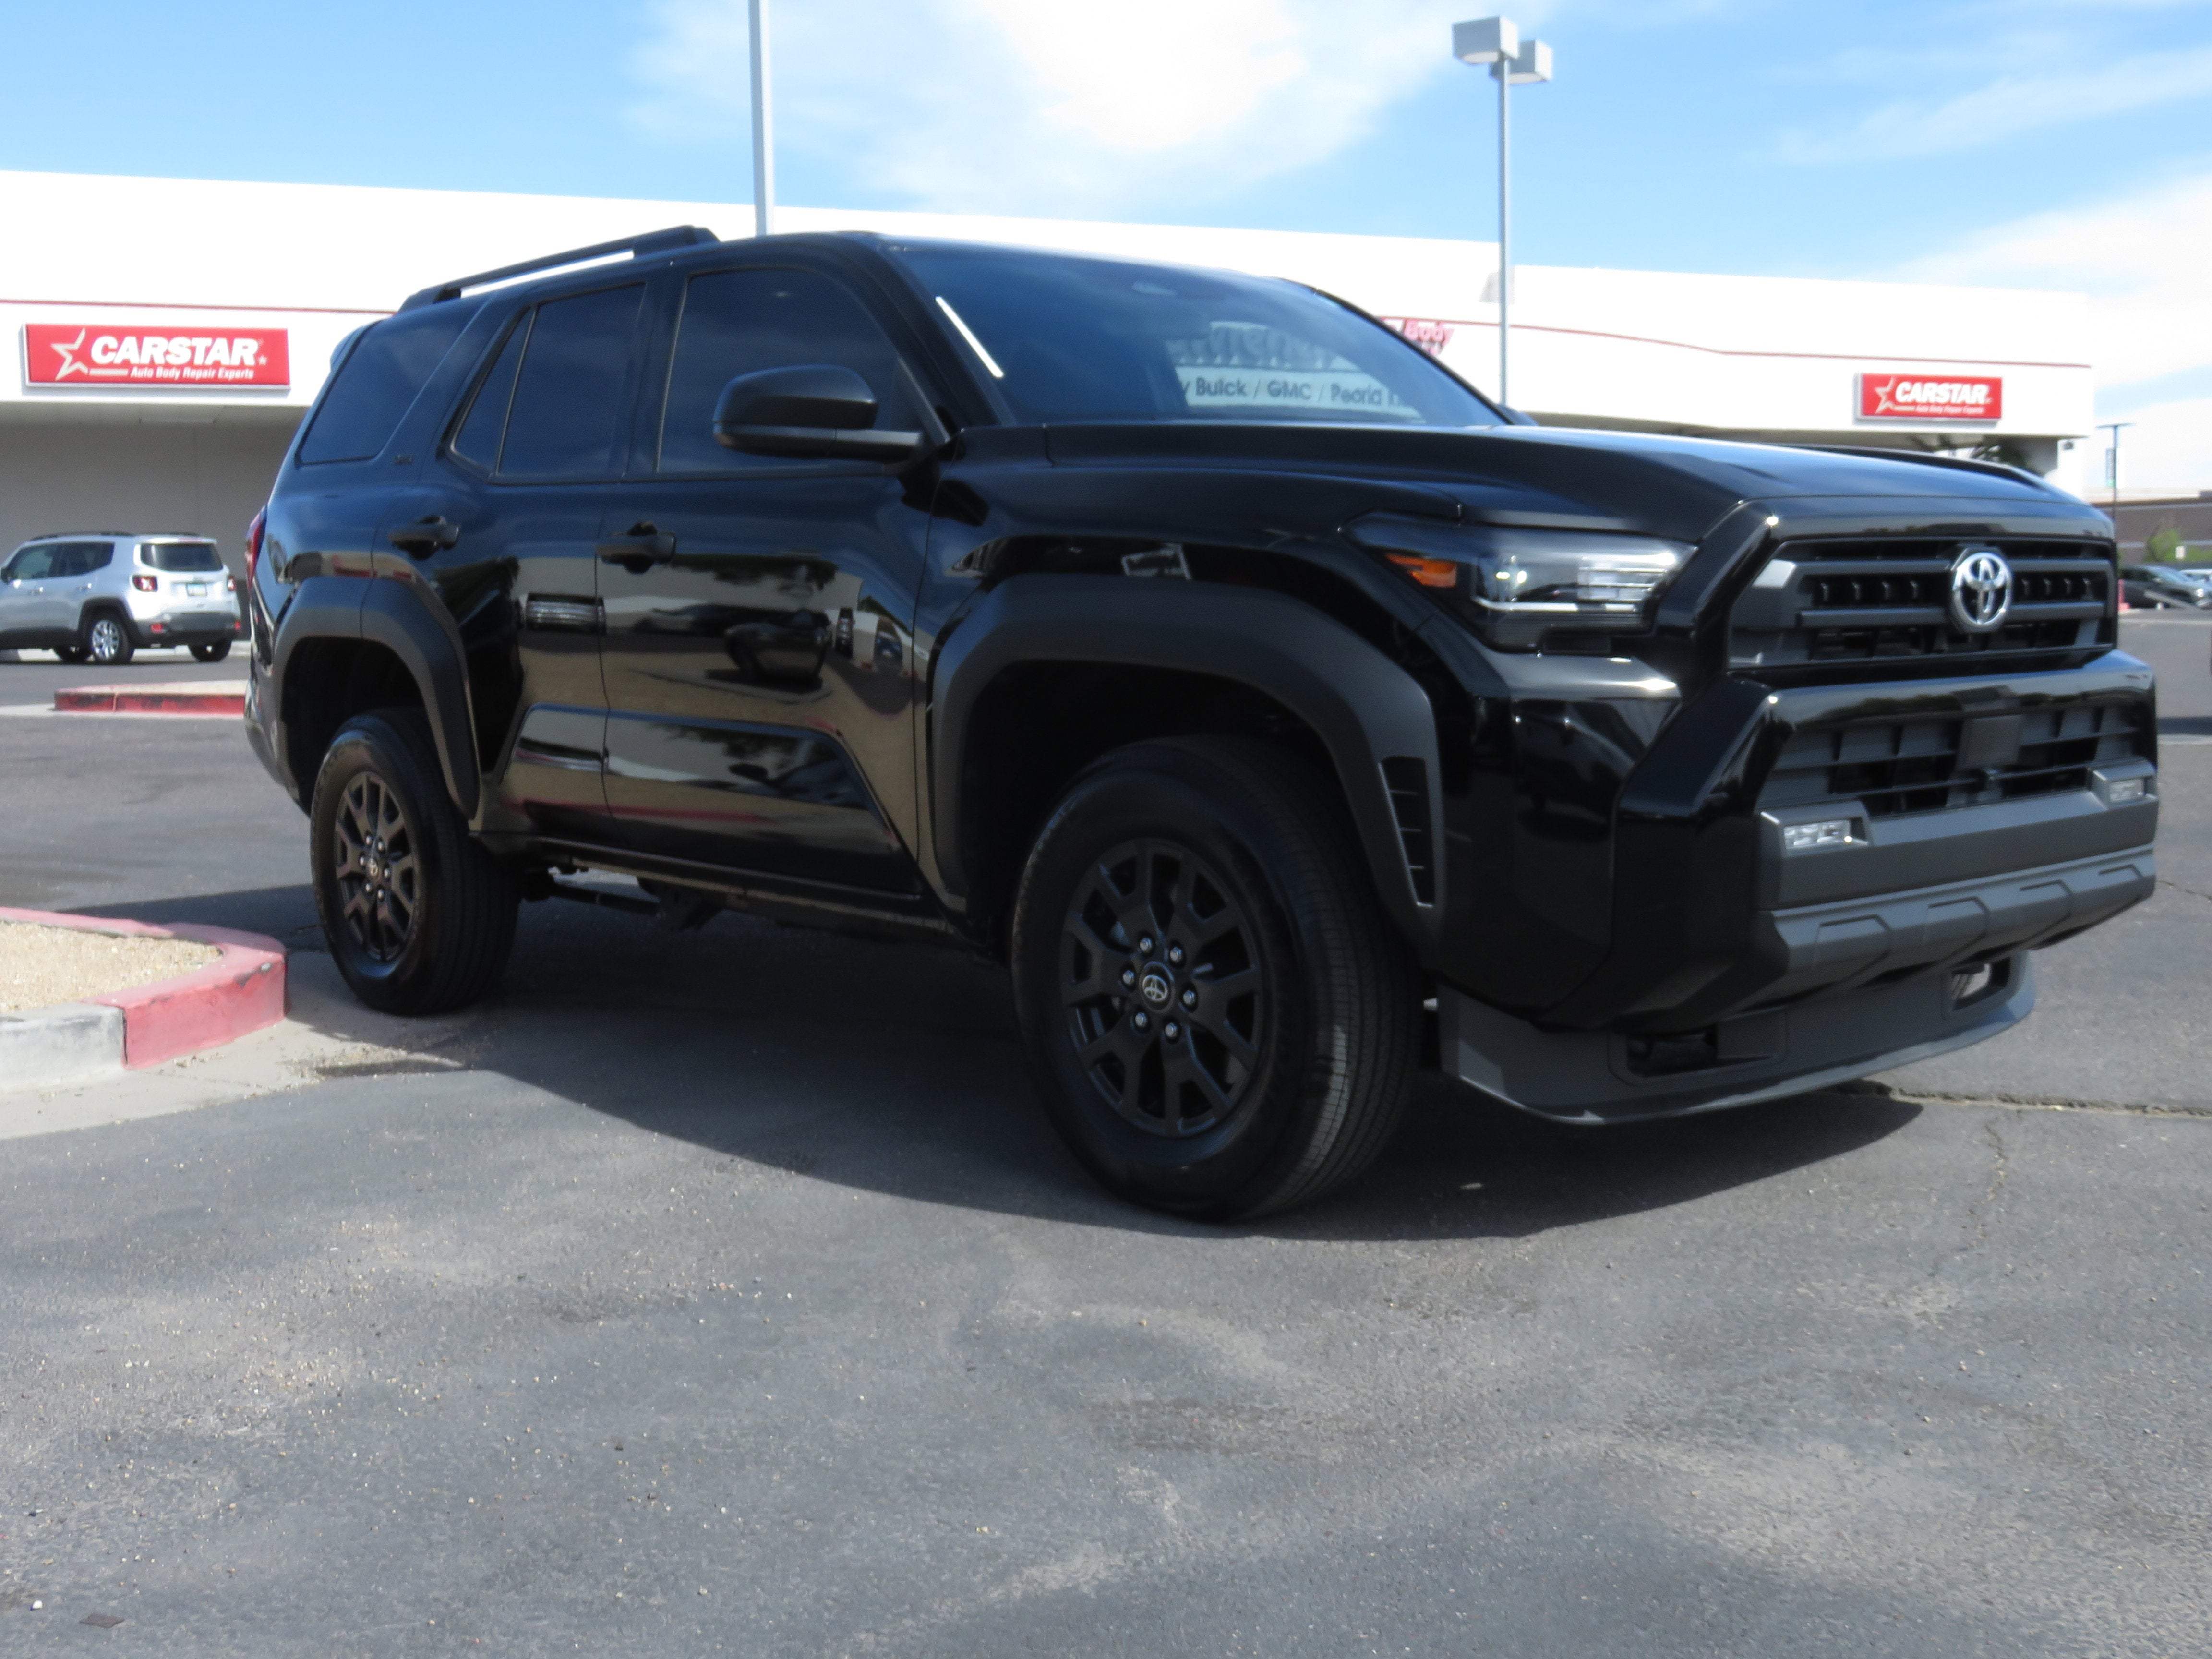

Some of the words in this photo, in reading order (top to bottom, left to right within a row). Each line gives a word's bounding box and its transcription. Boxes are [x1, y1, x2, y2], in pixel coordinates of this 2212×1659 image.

[1404, 319, 1455, 347] Body
[91, 335, 259, 366] CARSTAR
[130, 366, 154, 378] Auto
[156, 366, 181, 381] Body
[182, 367, 216, 381] Repair
[217, 367, 254, 381] Experts
[1196, 376, 1247, 397] Buick
[1267, 379, 1311, 400] GMC
[1331, 382, 1382, 405] Peoria
[1895, 381, 1990, 404] CARSTAR
